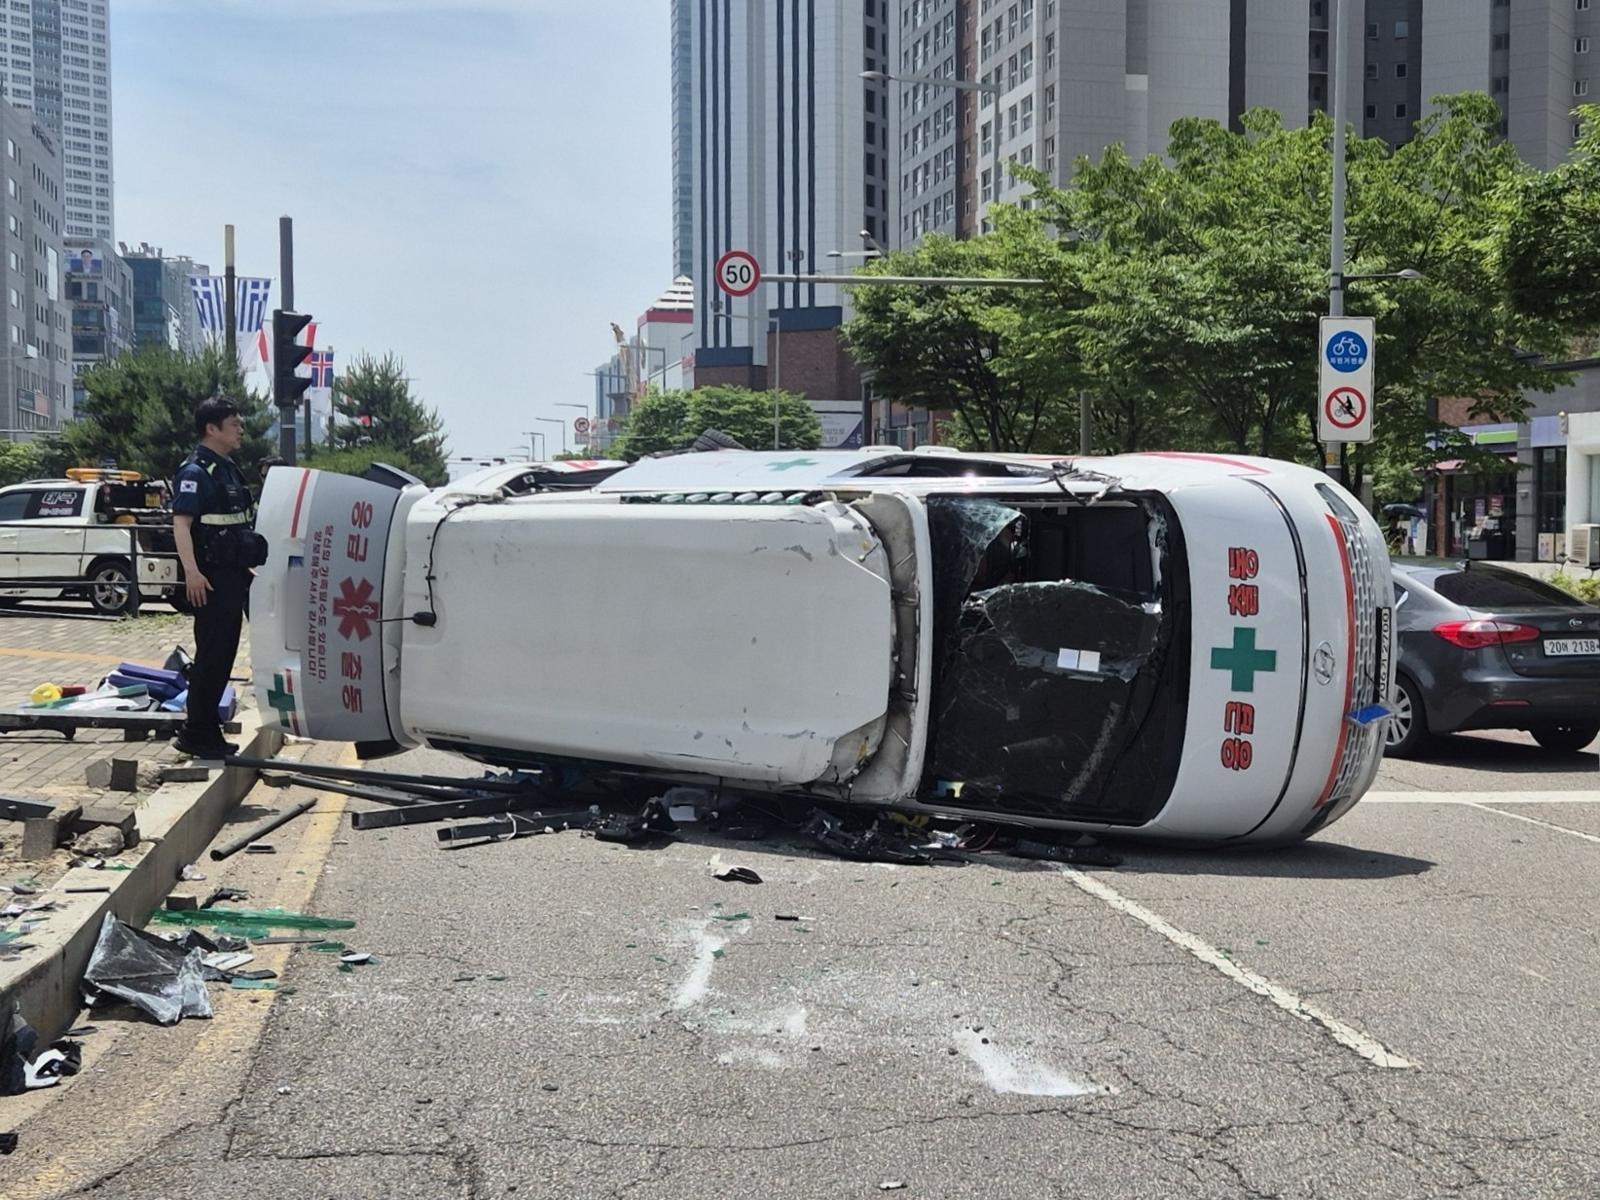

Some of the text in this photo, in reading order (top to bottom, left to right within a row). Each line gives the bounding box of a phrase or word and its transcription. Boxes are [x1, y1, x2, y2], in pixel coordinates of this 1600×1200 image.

[726, 265, 751, 284] 50
[322, 524, 334, 561] 당신의
[341, 501, 373, 713] 응급 출동
[1220, 546, 1259, 771] 응급 출동
[1571, 640, 1596, 653] 2138
